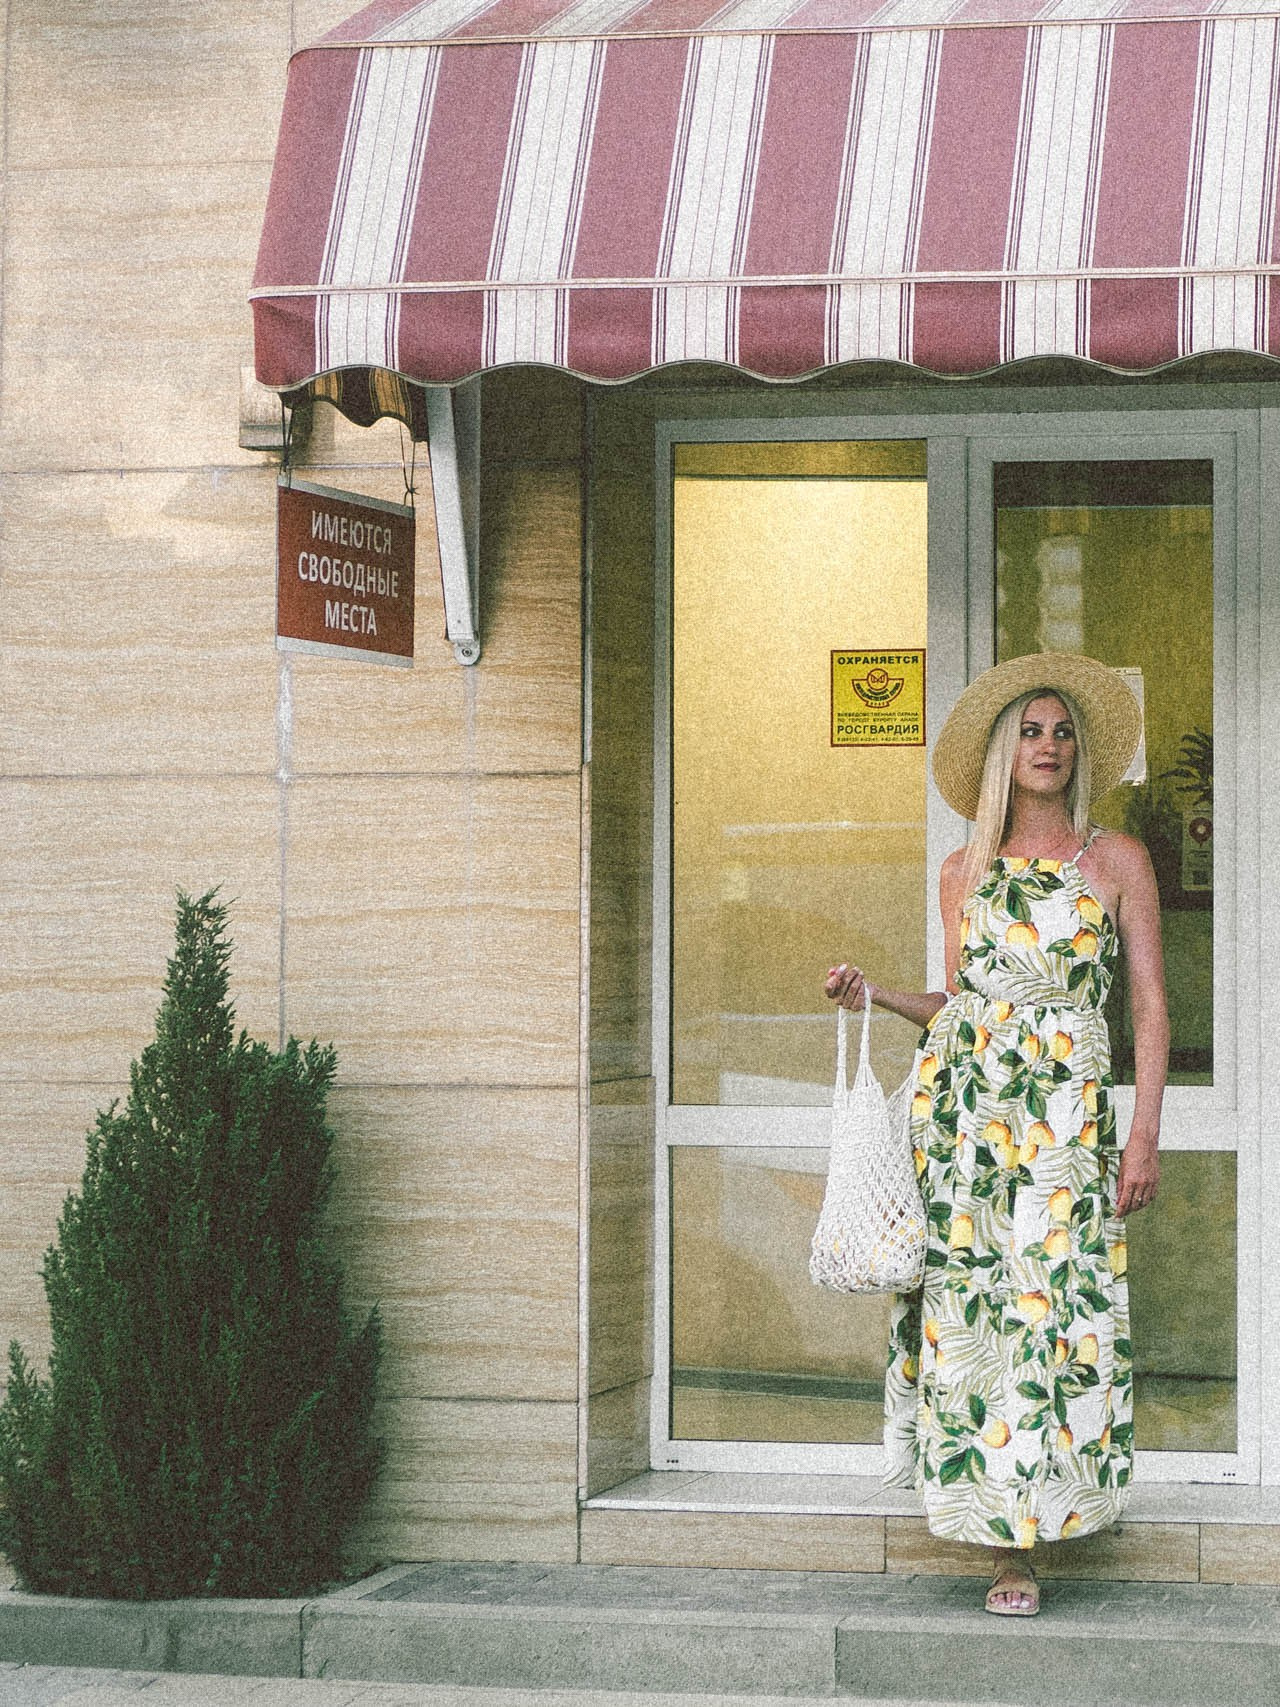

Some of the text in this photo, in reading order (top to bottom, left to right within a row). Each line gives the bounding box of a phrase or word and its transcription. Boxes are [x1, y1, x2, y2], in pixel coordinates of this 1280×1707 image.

[312, 510, 392, 555] ИМЕЮТСЯ
[298, 551, 399, 598] СВОБОДНЫЕ
[325, 600, 377, 636] МЕСТА
[837, 656, 919, 665] ОХРАНЯЕТСЯ
[837, 724, 919, 736] РОСГВАРДИЯ
